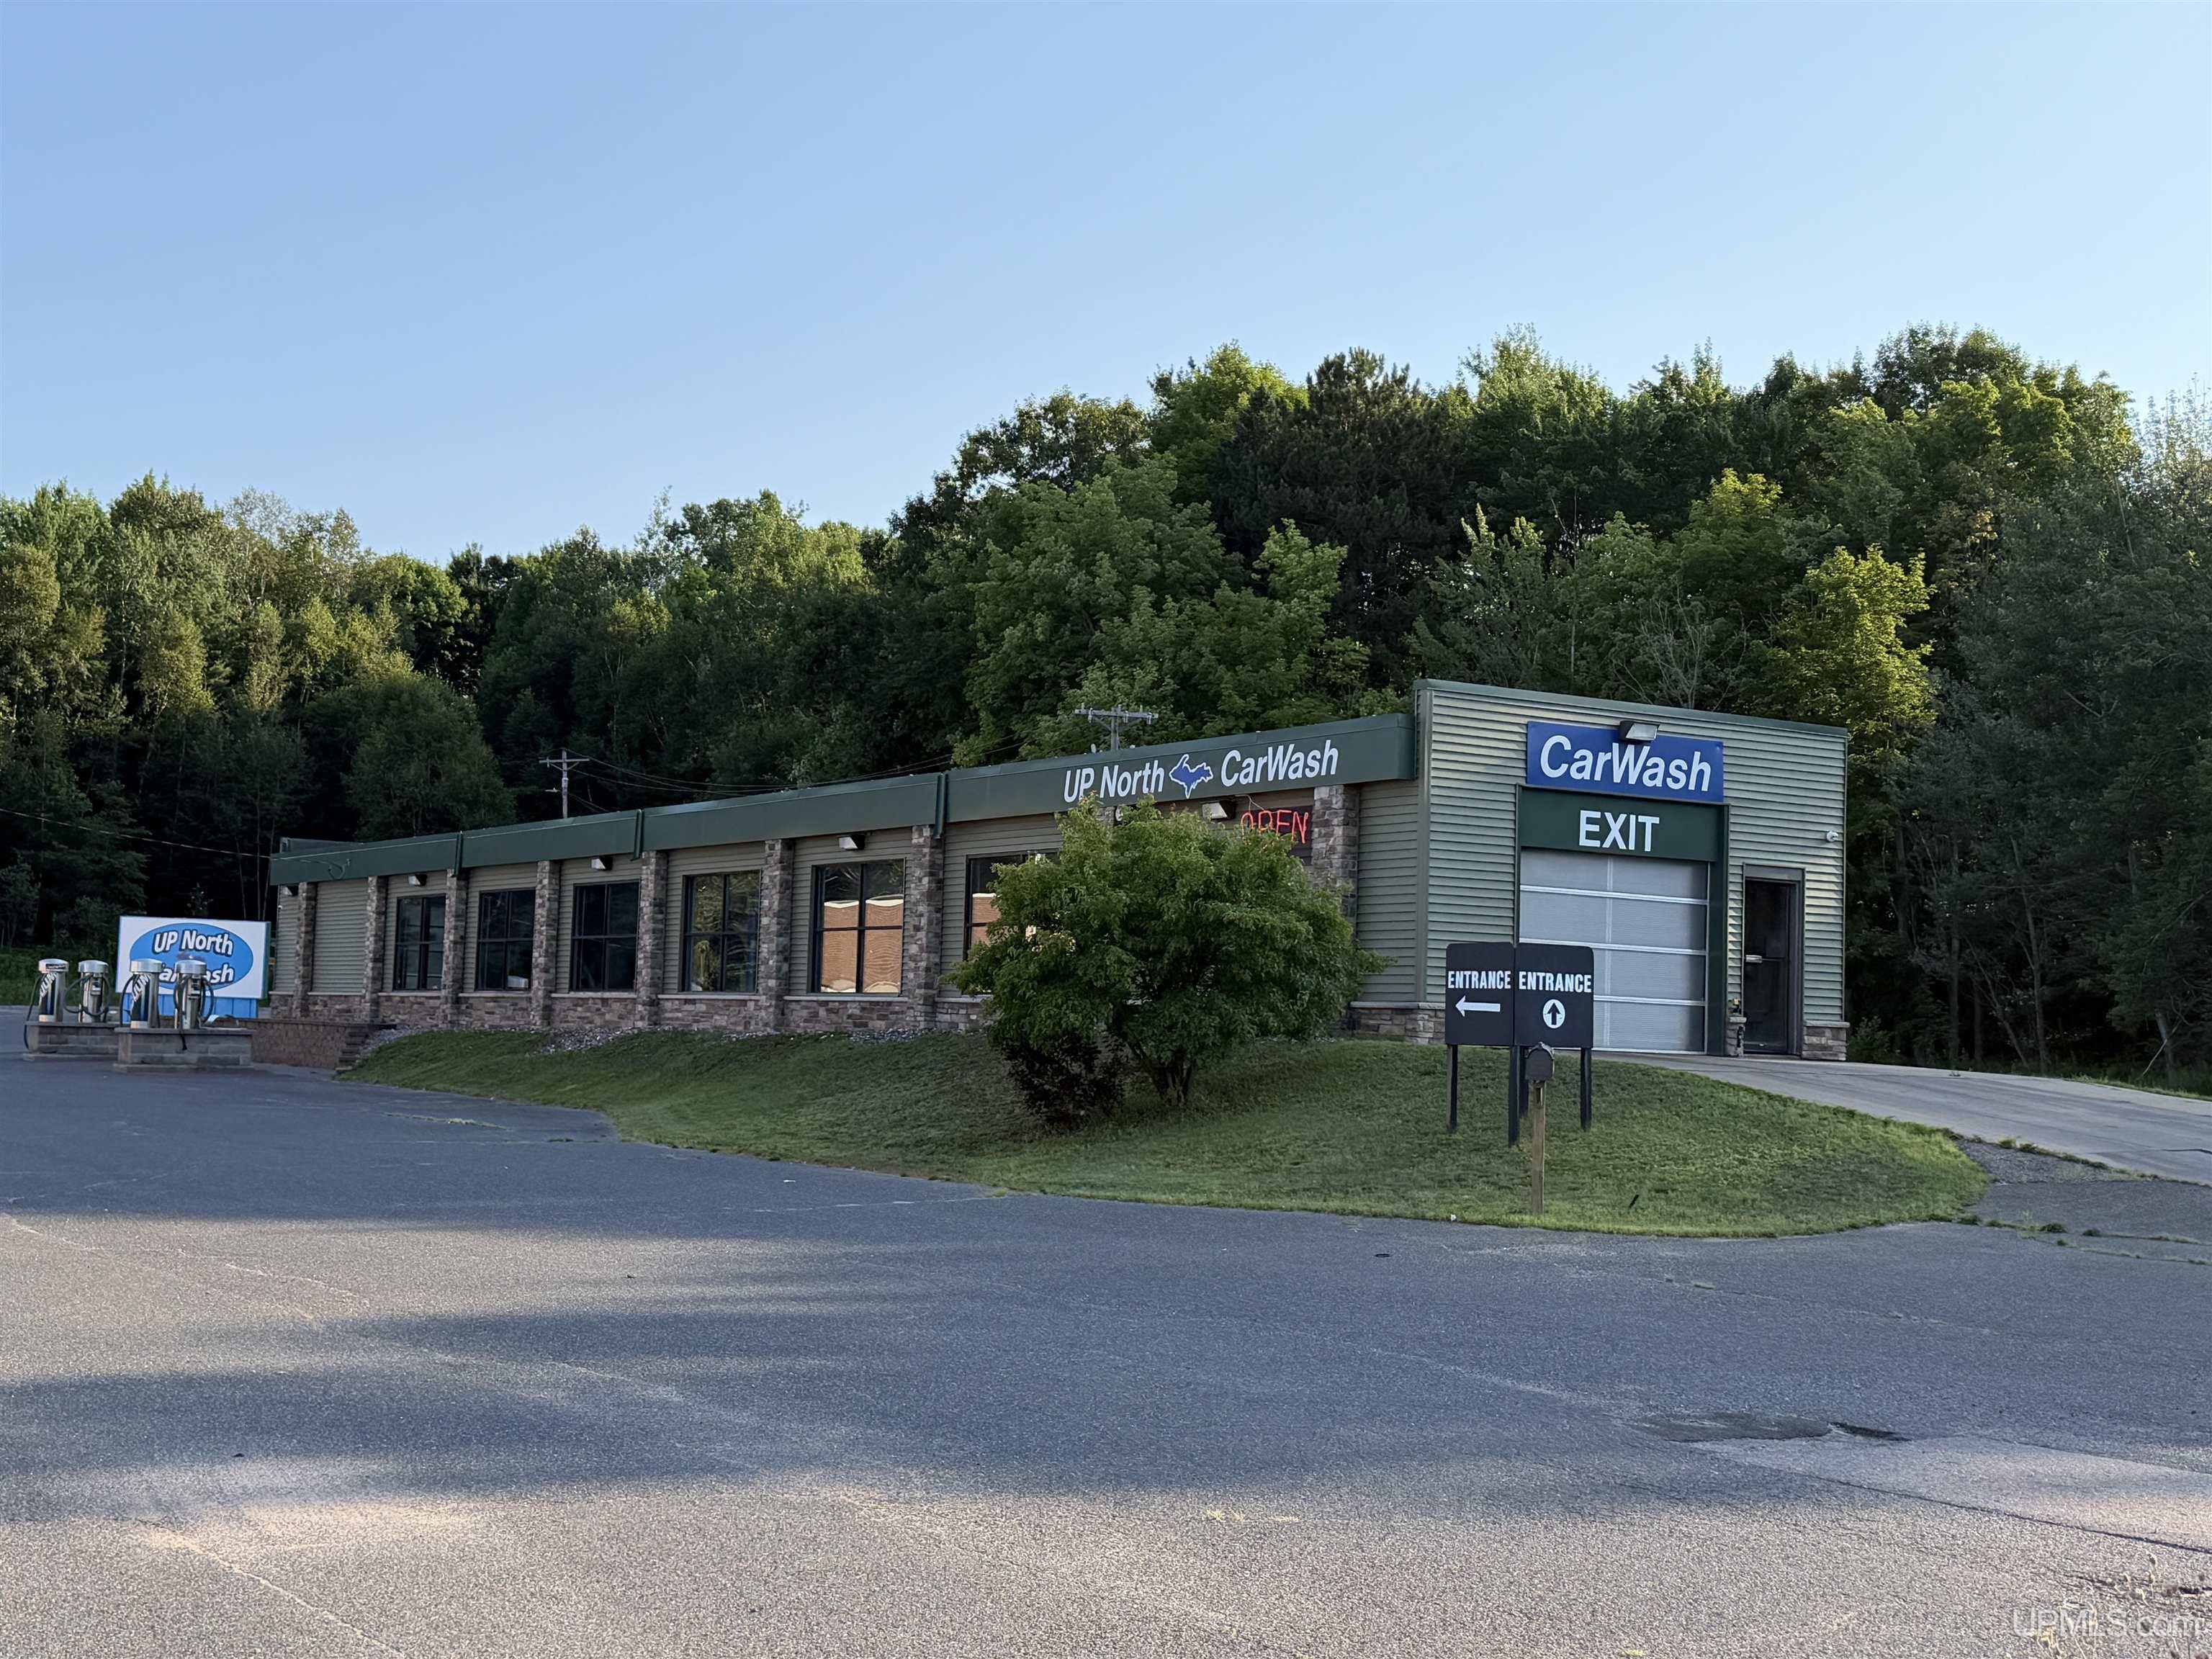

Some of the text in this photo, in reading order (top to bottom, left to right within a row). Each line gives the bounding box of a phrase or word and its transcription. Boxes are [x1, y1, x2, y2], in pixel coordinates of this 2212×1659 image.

[1064, 739, 1339, 803] UP North CarWash
[1539, 734, 1712, 792] CarWash
[1578, 809, 1660, 852] EXIT
[153, 930, 234, 956] UP North
[1447, 970, 1511, 989] ENTRANCE
[1519, 971, 1592, 993] ENTRANCE
